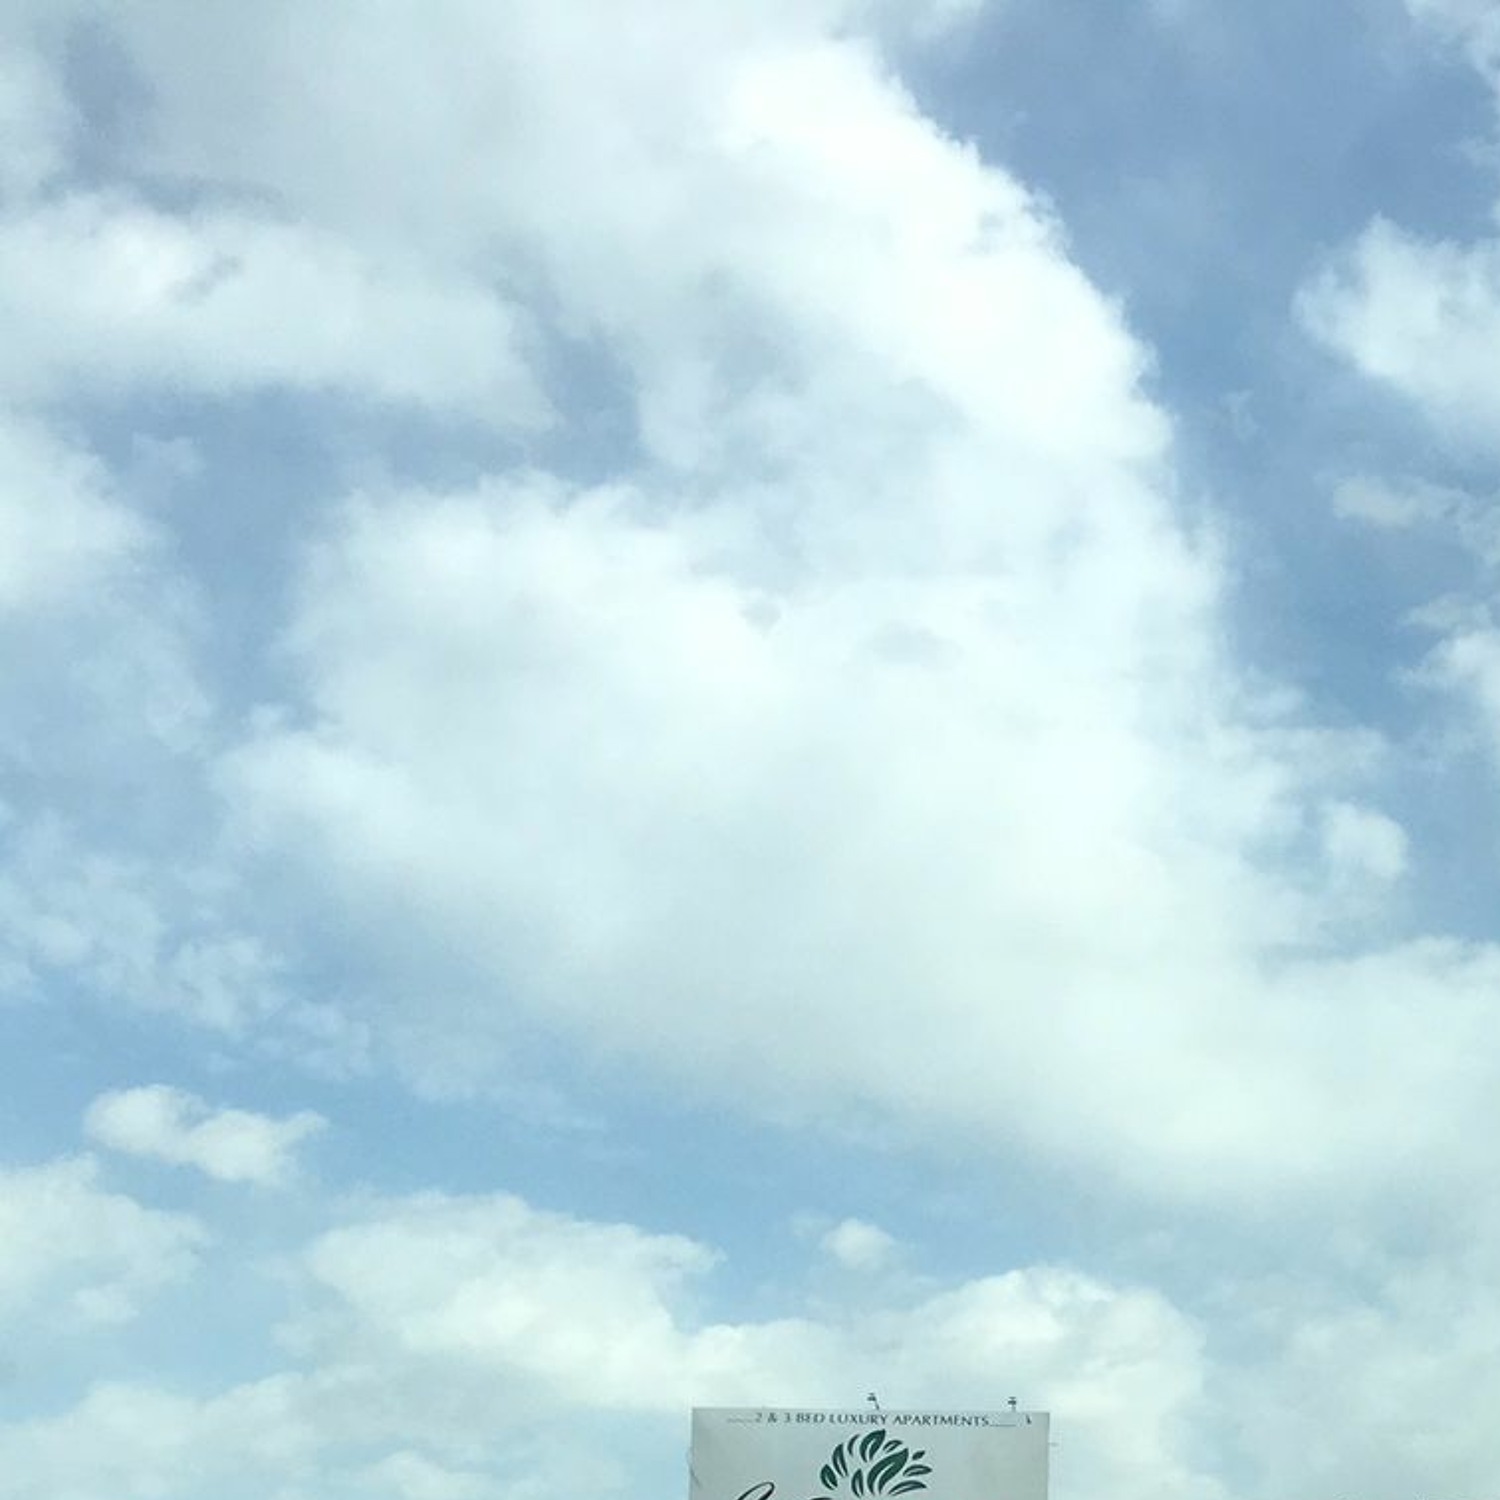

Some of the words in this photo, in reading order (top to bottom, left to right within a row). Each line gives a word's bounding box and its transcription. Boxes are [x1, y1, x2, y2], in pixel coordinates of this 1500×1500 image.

[767, 1412, 778, 1423] &
[795, 1412, 825, 1424] BED
[829, 1413, 888, 1426] LUXURY
[892, 1414, 990, 1427] APARTMENTS
